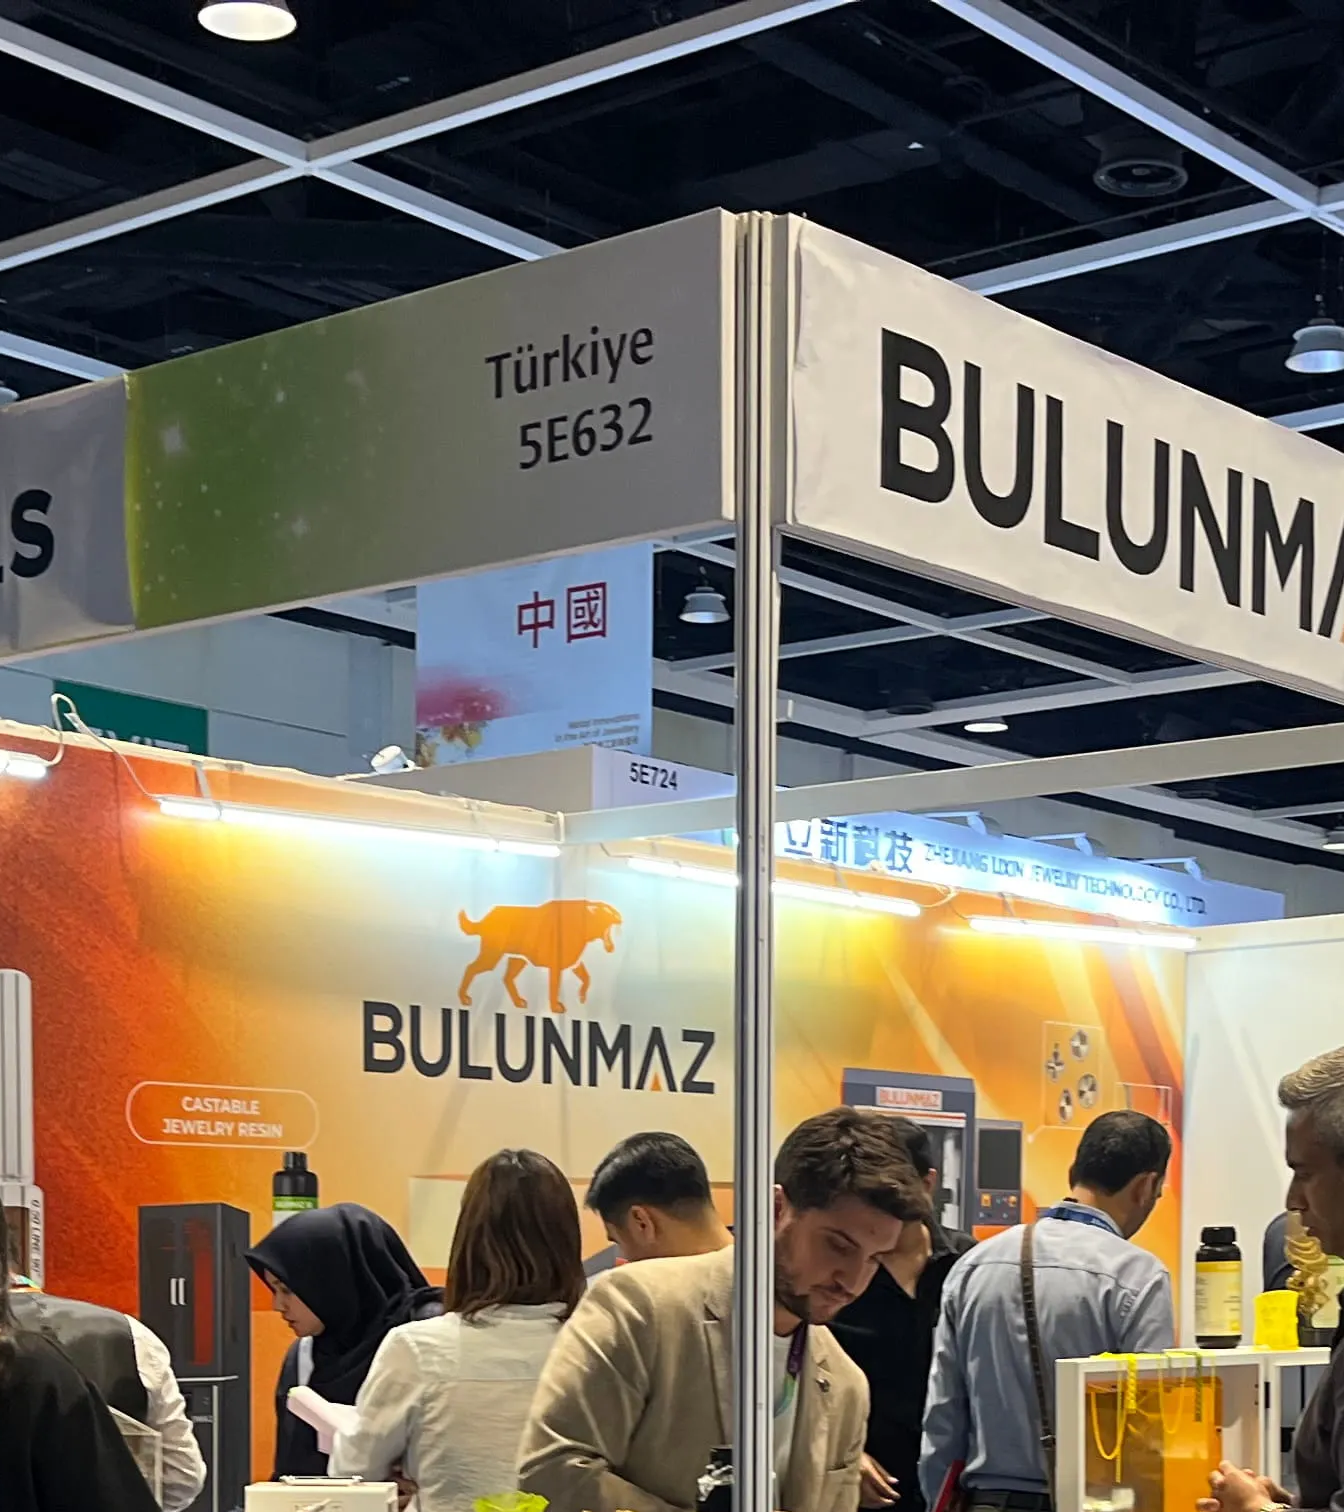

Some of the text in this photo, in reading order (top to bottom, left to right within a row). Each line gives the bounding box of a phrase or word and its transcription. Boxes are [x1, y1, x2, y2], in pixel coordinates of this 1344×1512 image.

[485, 325, 654, 399] Türkiye
[518, 397, 654, 469] 5E632
[517, 582, 607, 648] 中國
[629, 762, 678, 790] 5E724
[924, 842, 988, 872] ZHEJIANG
[362, 1000, 716, 1095] BULUNMAZ
[162, 1118, 283, 1138] JEWELRY RESIN
[181, 1096, 260, 1115] CASTABLE
